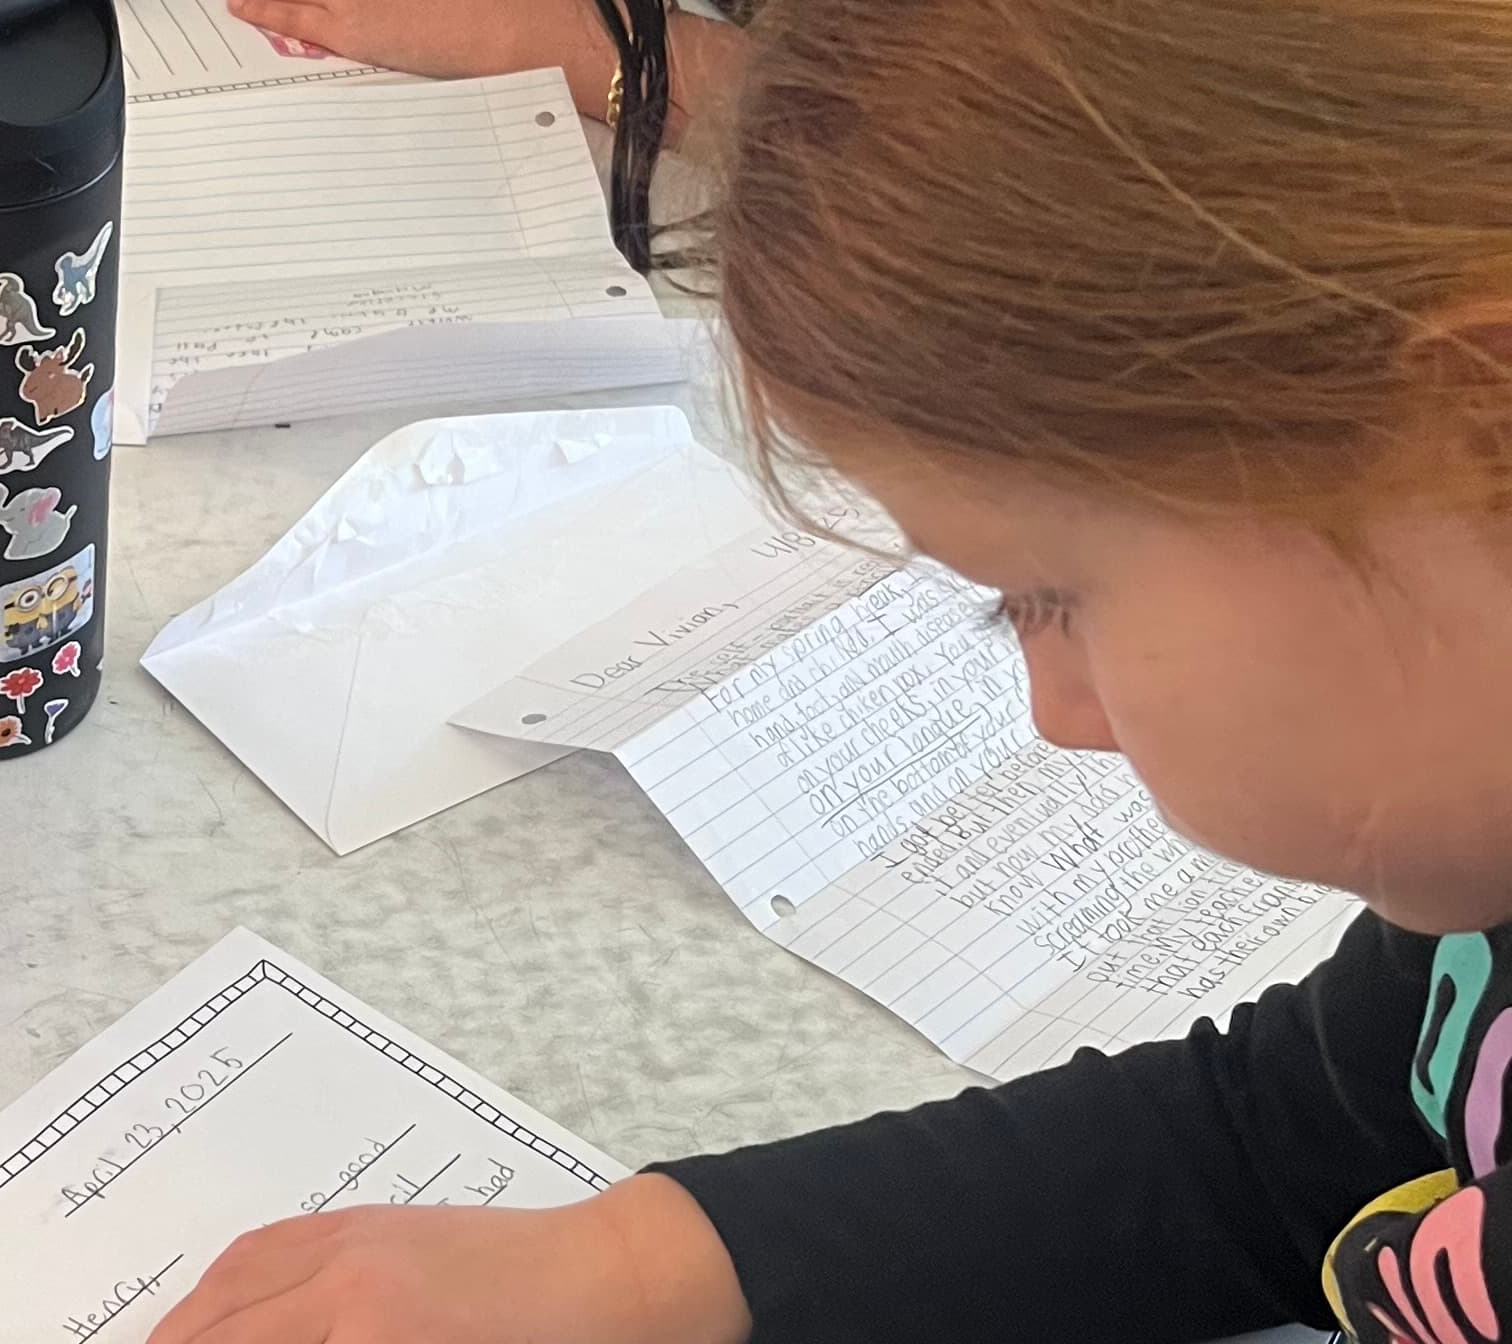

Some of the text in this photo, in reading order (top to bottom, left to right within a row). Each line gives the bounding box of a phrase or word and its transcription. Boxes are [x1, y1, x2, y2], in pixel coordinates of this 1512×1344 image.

[570, 603, 738, 689] Dear Vivian,
[701, 616, 848, 713] For my spring
[727, 695, 772, 727] home
[809, 783, 844, 815] on
[843, 747, 896, 796] your
[815, 738, 860, 787] your
[987, 782, 1043, 816] then
[949, 879, 995, 909] but
[984, 825, 1103, 916] know What
[1016, 891, 1070, 935] with
[1034, 884, 1129, 955] screaming
[1094, 905, 1144, 943] took
[1143, 883, 1178, 911] me
[1140, 956, 1198, 1003] that
[1177, 963, 1225, 999] has
[61, 1152, 122, 1205] April
[164, 1047, 243, 1113] 2025
[300, 1191, 326, 1217] so
[338, 1137, 385, 1191] good
[464, 1157, 515, 1196] had
[63, 1277, 160, 1337] Henry,
